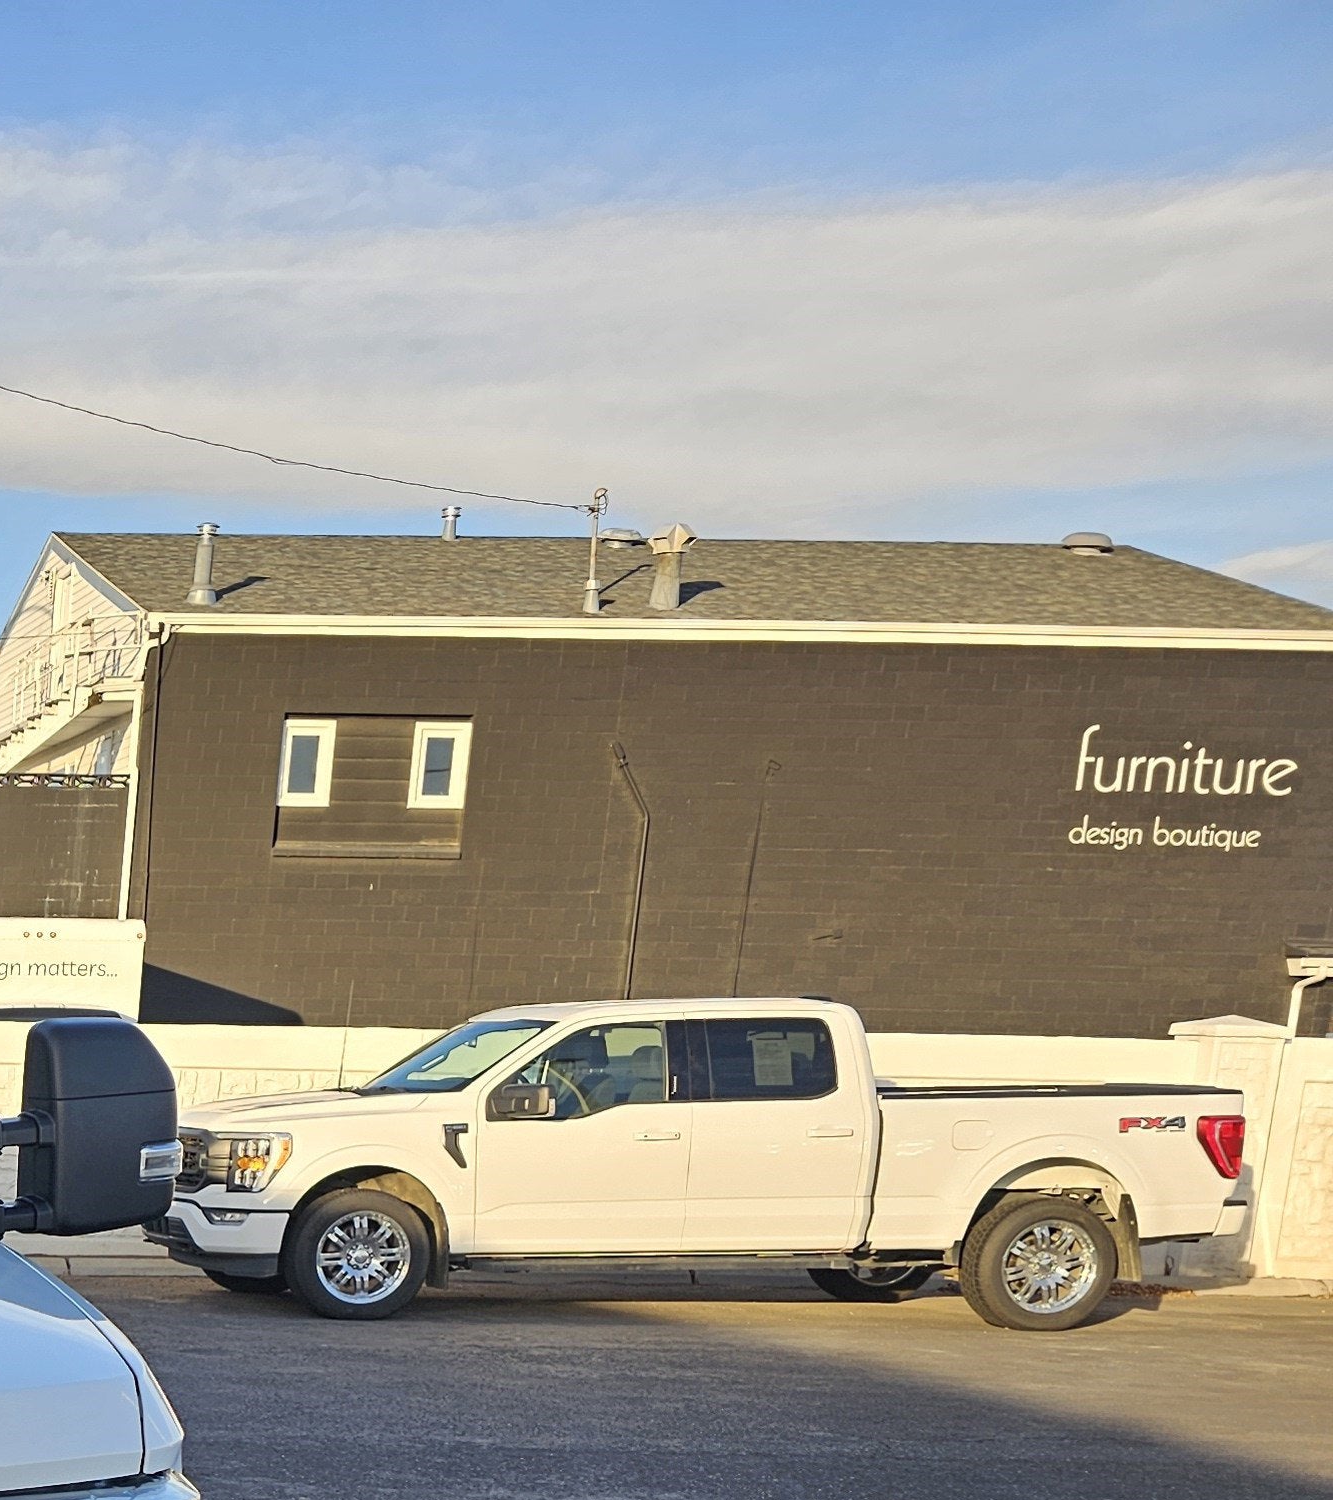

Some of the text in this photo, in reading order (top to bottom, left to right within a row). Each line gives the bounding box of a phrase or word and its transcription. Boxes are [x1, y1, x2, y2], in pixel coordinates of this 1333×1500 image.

[1074, 723, 1298, 797] furniture
[1068, 815, 1262, 852] design boutique
[27, 961, 118, 978] matters...
[1119, 1116, 1186, 1133] FX4
